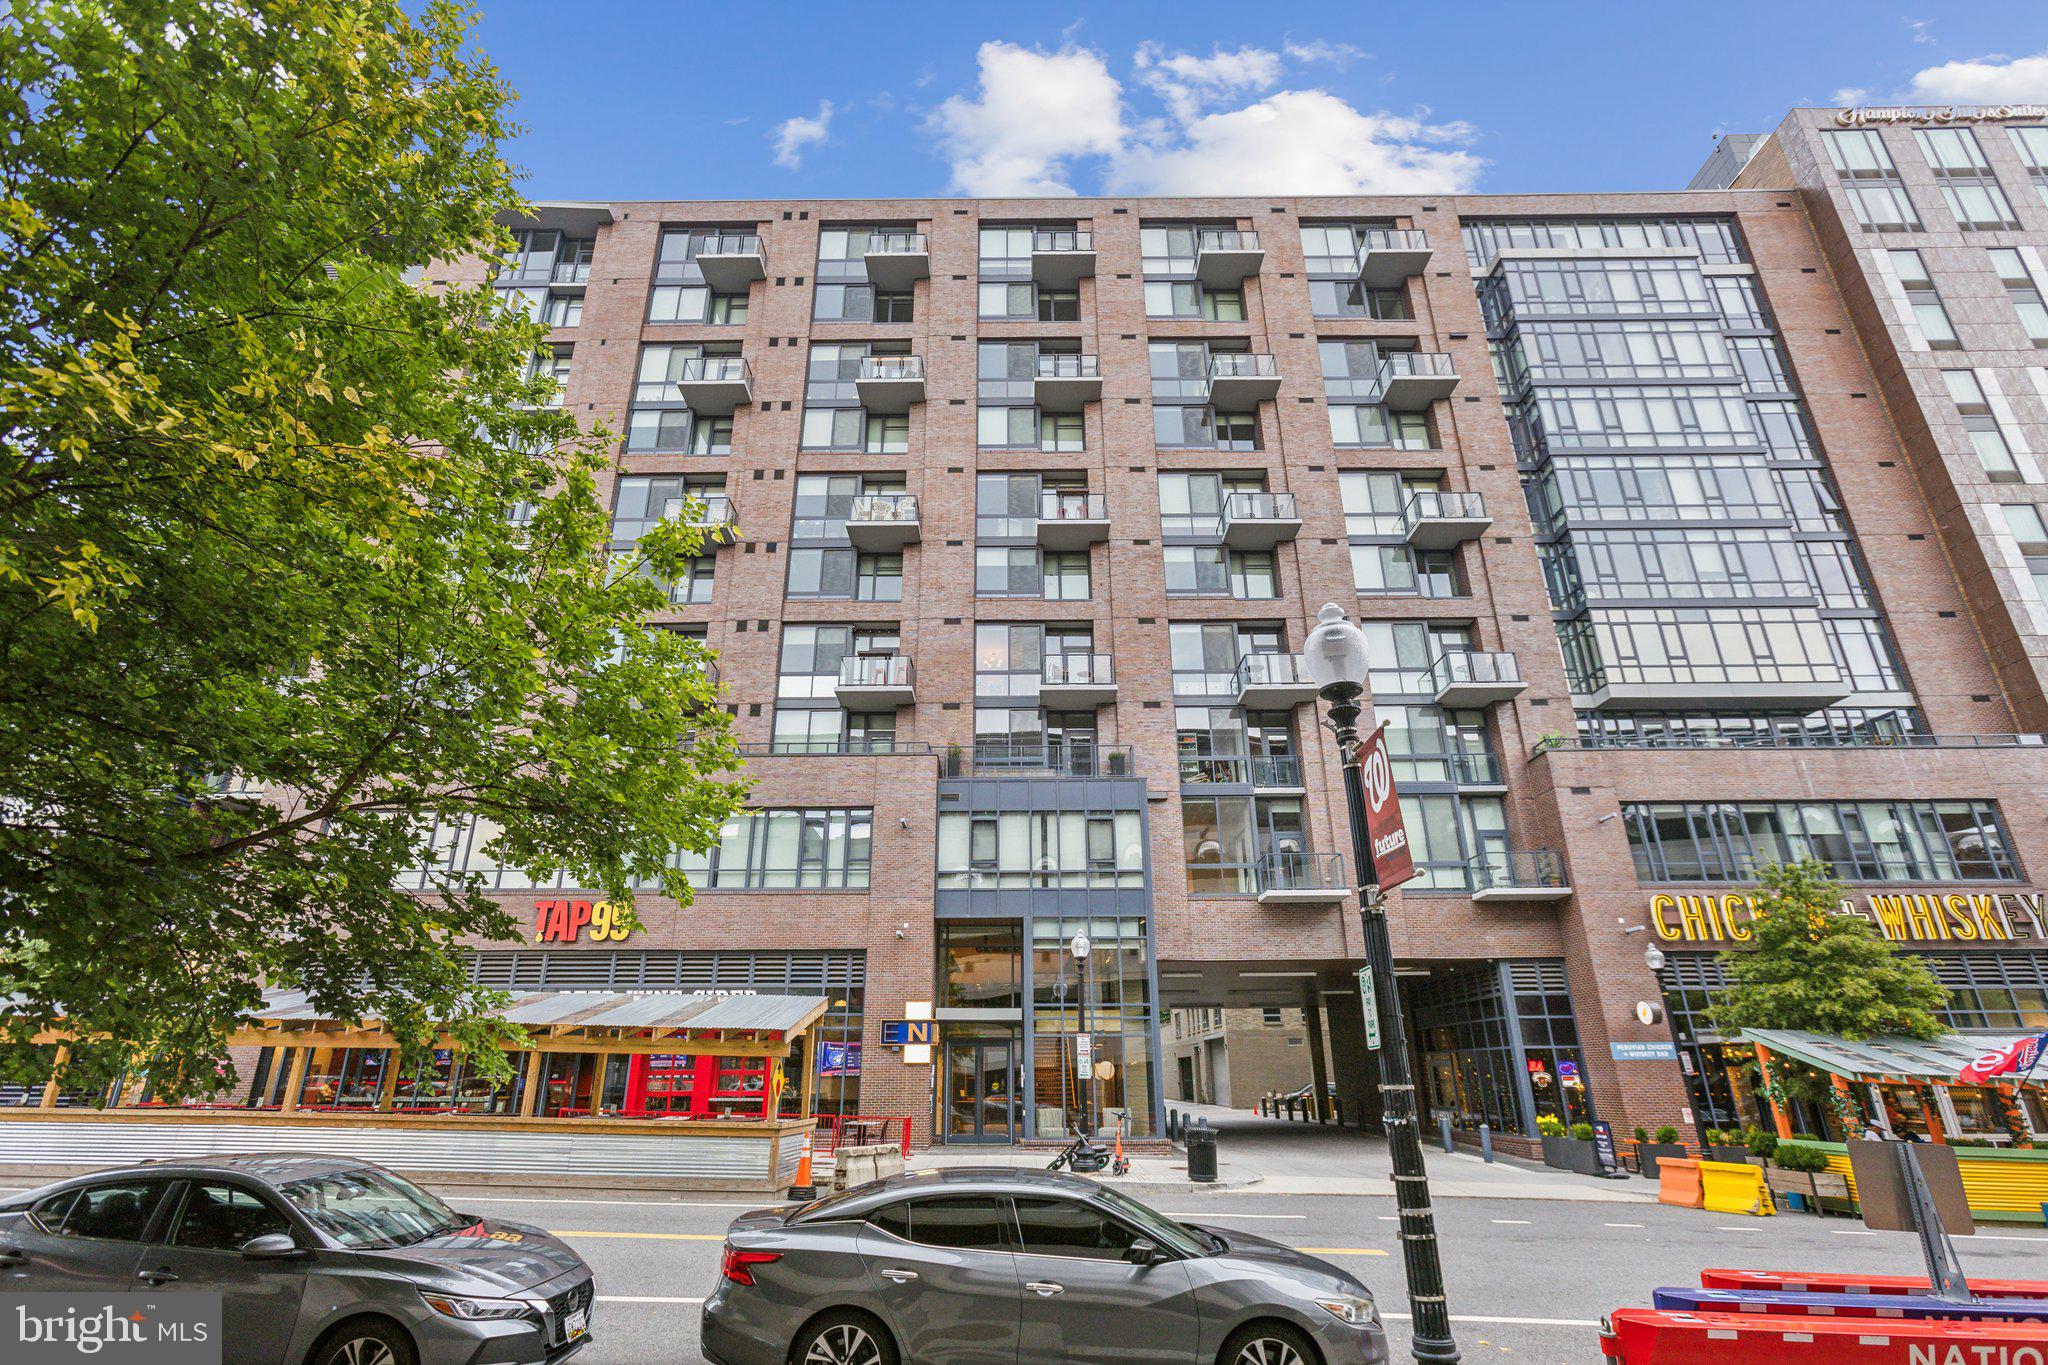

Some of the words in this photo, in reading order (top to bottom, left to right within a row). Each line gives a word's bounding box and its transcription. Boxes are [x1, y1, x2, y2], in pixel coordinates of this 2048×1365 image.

[1836, 105, 1935, 125] Hampton
[1364, 738, 1390, 813] W
[1374, 828, 1406, 857] future
[1866, 894, 2048, 940] WHISKEY
